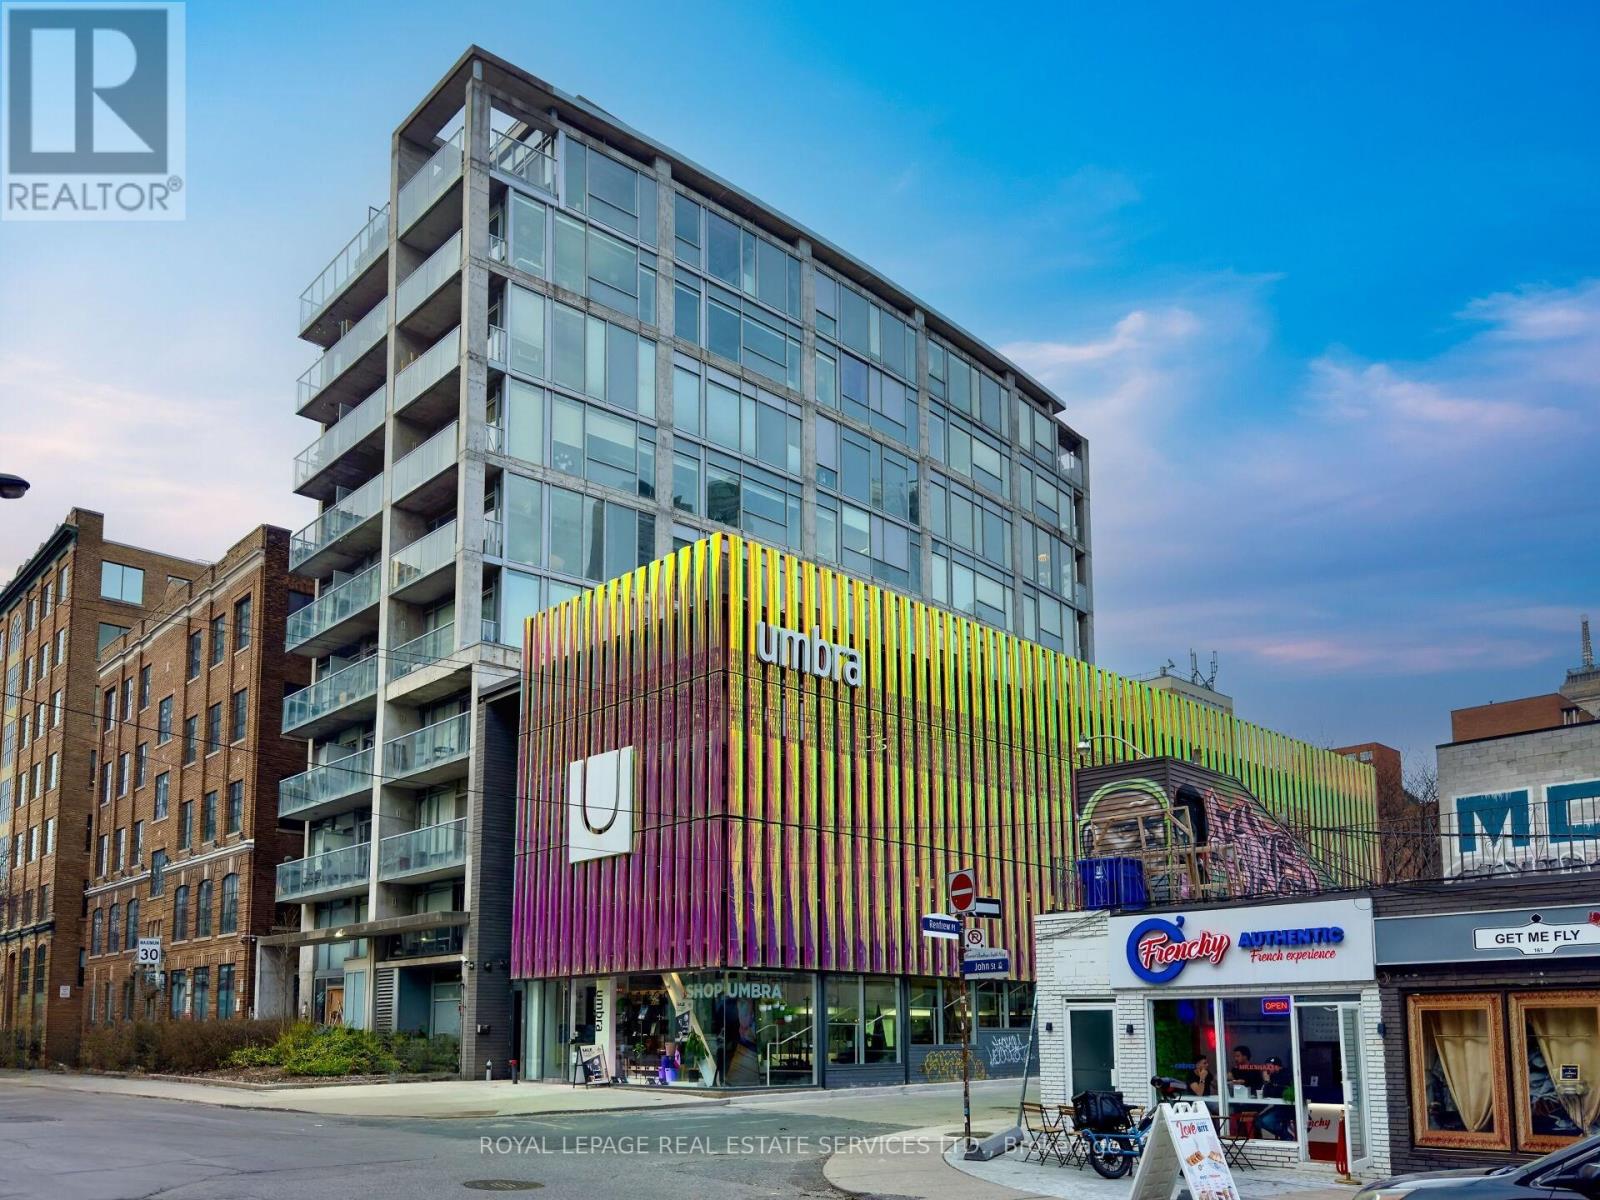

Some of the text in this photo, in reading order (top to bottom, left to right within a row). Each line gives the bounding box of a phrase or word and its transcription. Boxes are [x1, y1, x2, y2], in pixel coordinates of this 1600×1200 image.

[757, 620, 862, 688] umbra
[1239, 926, 1344, 949] AUTHENTIC
[1495, 929, 1580, 944] GET ME FLY
[140, 948, 158, 961] 30
[1138, 930, 1231, 969] Frenchy
[1250, 947, 1336, 964] French experience
[974, 962, 990, 972] John
[686, 982, 782, 999] SHOP UMBRA
[596, 990, 605, 1032] umbra
[1265, 1002, 1288, 1010] OPEN
[1176, 1120, 1196, 1139] Love
